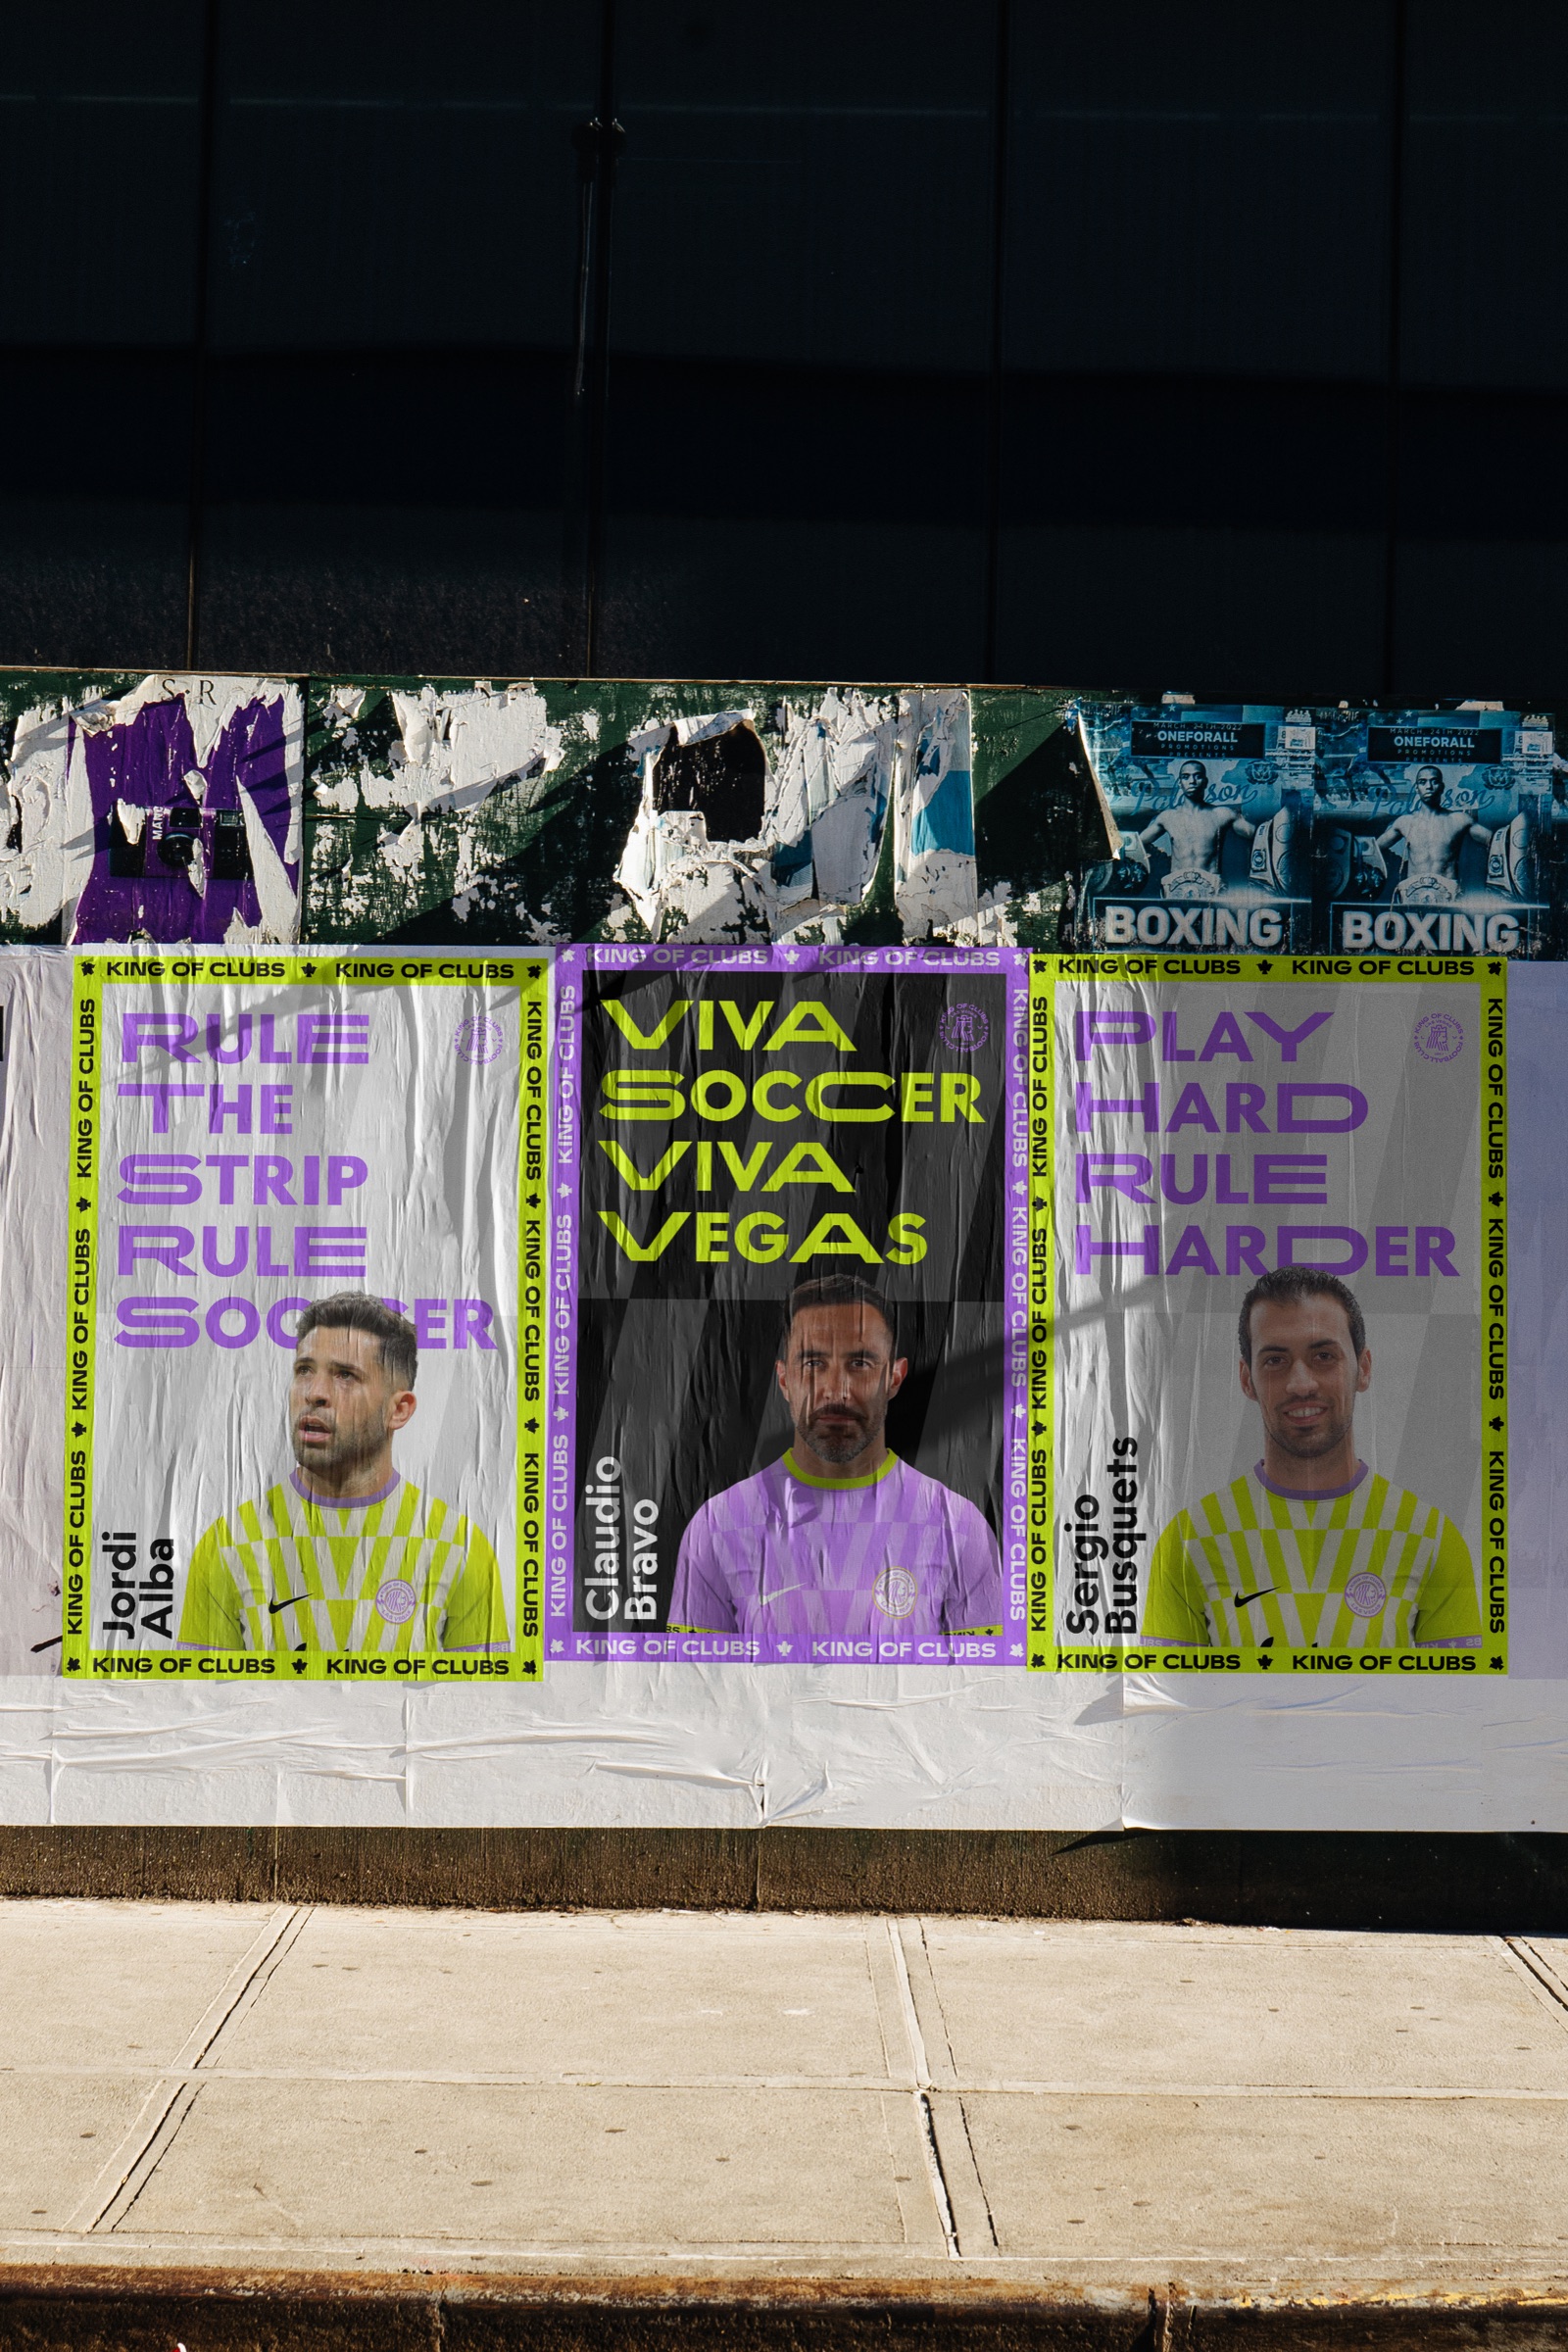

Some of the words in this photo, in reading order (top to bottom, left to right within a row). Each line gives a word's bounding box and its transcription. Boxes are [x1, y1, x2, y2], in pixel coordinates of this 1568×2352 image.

[1157, 730, 1239, 743] ONEFORALL
[1393, 736, 1476, 749] ONEFORALL
[1104, 905, 1284, 948] BOXING
[1342, 910, 1521, 954] BOXING
[106, 960, 166, 977] KING
[172, 961, 204, 977] OF
[209, 961, 285, 978] CLUBS
[335, 962, 395, 979] KING
[400, 963, 433, 979] OF
[438, 963, 514, 979] CLUBS
[586, 948, 648, 963] KING
[652, 948, 685, 964] OF
[690, 949, 768, 965] CLUBS
[818, 950, 879, 966] KING
[884, 950, 918, 966] OF
[922, 951, 1001, 967] CLUBS
[1058, 958, 1119, 974] KING
[1124, 958, 1157, 975] OF
[1162, 958, 1242, 975] CLUBS
[1292, 959, 1352, 975] KING
[1357, 959, 1392, 976] OF
[1396, 959, 1475, 976] CLUBS
[78, 998, 95, 1075] CLUBS
[122, 1013, 368, 1064] RULE
[483, 1016, 504, 1037] CLUBS
[526, 1001, 542, 1060] KING
[559, 985, 576, 1061] CLUBS
[599, 999, 858, 1053] VIVA
[968, 1004, 989, 1024] CLUBS
[1012, 988, 1030, 1049] KING
[1032, 996, 1049, 1073] CLUBS
[1075, 1010, 1335, 1062] PLAY
[1443, 1013, 1464, 1035] CLUBS
[1488, 998, 1503, 1057] KING
[77, 1080, 94, 1112] OF
[526, 1065, 542, 1099] OF
[558, 1066, 574, 1100] OF
[599, 1069, 986, 1124] SOCCER
[1012, 1053, 1029, 1087] OF
[1032, 1079, 1048, 1112] OF
[1488, 1063, 1504, 1097] OF
[118, 1084, 292, 1134] THE
[558, 1104, 574, 1164] KING
[1011, 1091, 1029, 1168] CLUBS
[1075, 1081, 1369, 1134] HARD
[76, 1118, 93, 1179] KING
[525, 1103, 542, 1181] CLUBS
[1032, 1116, 1048, 1177] KING
[1488, 1102, 1504, 1179] CLUBS
[117, 1154, 368, 1205] STRIP
[598, 1140, 856, 1195] VIVA
[1075, 1152, 1328, 1205] RULE
[118, 1225, 368, 1277] RULE
[524, 1219, 541, 1280] KING
[555, 1214, 572, 1292] CLUBS
[597, 1210, 928, 1265] VEGAS
[1011, 1205, 1028, 1267] KING
[1075, 1224, 1460, 1277] HARDER
[1489, 1218, 1504, 1279] KING
[74, 1228, 91, 1306] CLUBS
[1010, 1271, 1028, 1305] OF
[1031, 1228, 1048, 1305] CLUBS
[114, 1296, 498, 1349] SOCER
[524, 1285, 541, 1318] OF
[554, 1297, 571, 1330] OF
[1031, 1310, 1049, 1344] OF
[1489, 1284, 1504, 1317] OF
[73, 1310, 89, 1345] OF
[1010, 1310, 1027, 1389] CLUBS
[72, 1349, 88, 1410] KING
[524, 1324, 541, 1402] CLUBS
[554, 1335, 570, 1396] KING
[1031, 1349, 1048, 1410] KING
[1489, 1322, 1504, 1400] CLUBS
[69, 1449, 86, 1529] CLUBS
[523, 1452, 540, 1514] KING
[552, 1434, 569, 1512] CLUBS
[1010, 1438, 1027, 1499] KING
[1030, 1448, 1048, 1527] CLUBS
[1489, 1450, 1505, 1512] KING
[522, 1520, 540, 1553] OF
[551, 1517, 567, 1551] OF
[584, 1456, 621, 1620] Claudio
[1009, 1504, 1027, 1538] OF
[1104, 1437, 1147, 1634] Busquets
[1489, 1517, 1505, 1550] OF
[68, 1534, 84, 1568] OF
[624, 1498, 659, 1620] Bravo
[1030, 1532, 1047, 1565] OF
[1064, 1494, 1109, 1635] Sergio
[67, 1573, 83, 1636] KING
[102, 1531, 137, 1640] Jordi
[139, 1539, 174, 1640] Alba
[522, 1558, 540, 1638] CLUBS
[550, 1556, 567, 1617] KING
[1009, 1543, 1027, 1622] CLUBS
[1030, 1571, 1047, 1632] KING
[1489, 1555, 1505, 1634] CLUBS
[92, 1657, 154, 1674] KING
[158, 1657, 192, 1674] OF
[197, 1657, 275, 1675] CLUBS
[326, 1658, 387, 1675] KING
[393, 1658, 426, 1675] OF
[431, 1658, 510, 1676] CLUBS
[575, 1639, 638, 1655] KING
[643, 1640, 676, 1655] OF
[681, 1640, 761, 1657] CLUBS
[811, 1641, 873, 1657] KING
[878, 1642, 912, 1657] OF
[917, 1642, 997, 1658] CLUBS
[1056, 1653, 1118, 1670] KING
[1124, 1653, 1157, 1670] OF
[1162, 1653, 1242, 1671] CLUBS
[1293, 1654, 1353, 1671] KING
[1359, 1654, 1393, 1671] OF
[1397, 1654, 1477, 1671] CLUBS
